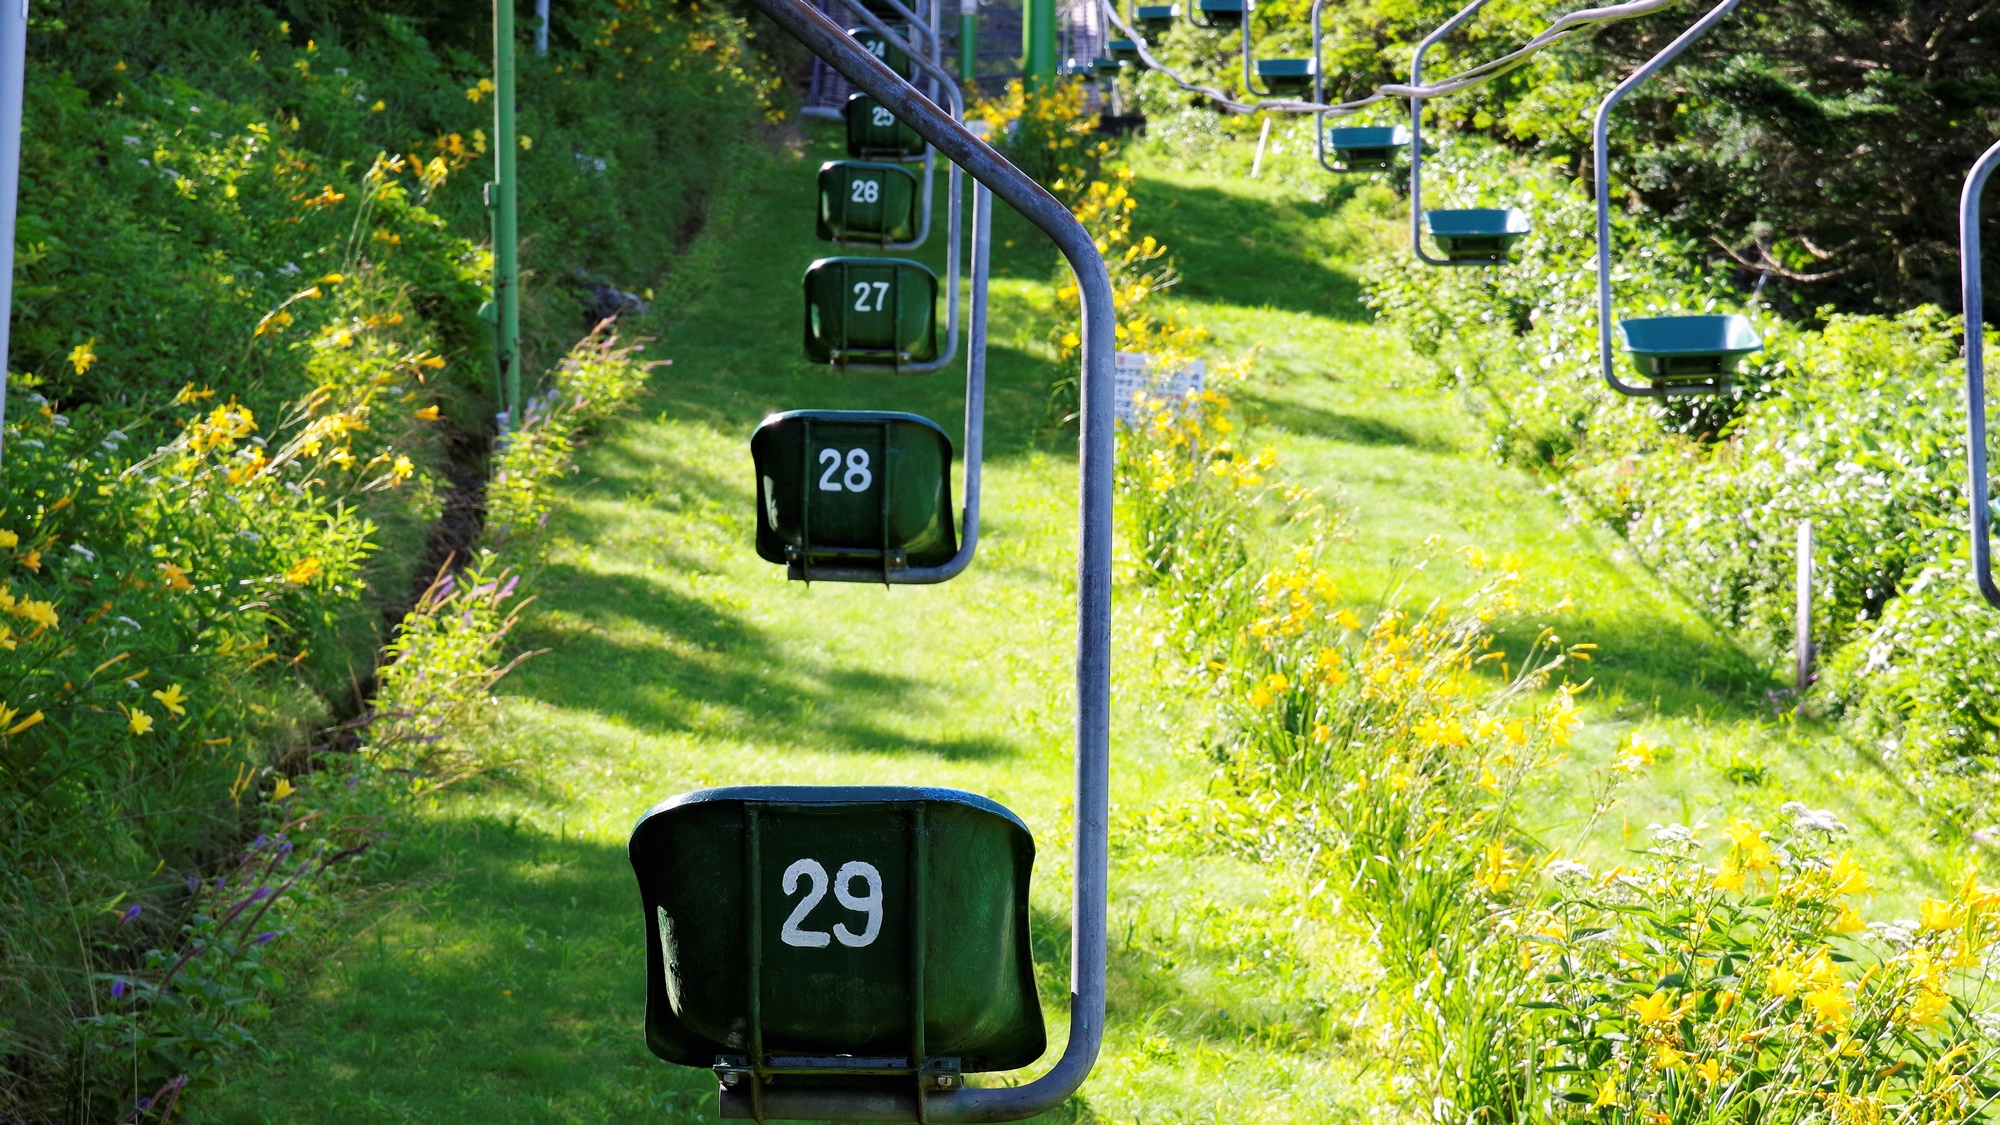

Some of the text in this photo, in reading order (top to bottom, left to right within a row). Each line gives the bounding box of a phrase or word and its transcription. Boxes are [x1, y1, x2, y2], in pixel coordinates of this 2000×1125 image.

[872, 106, 895, 126] 25
[852, 180, 879, 203] 26
[853, 281, 890, 312] 27
[818, 448, 873, 494] 28
[780, 858, 884, 949] 29
